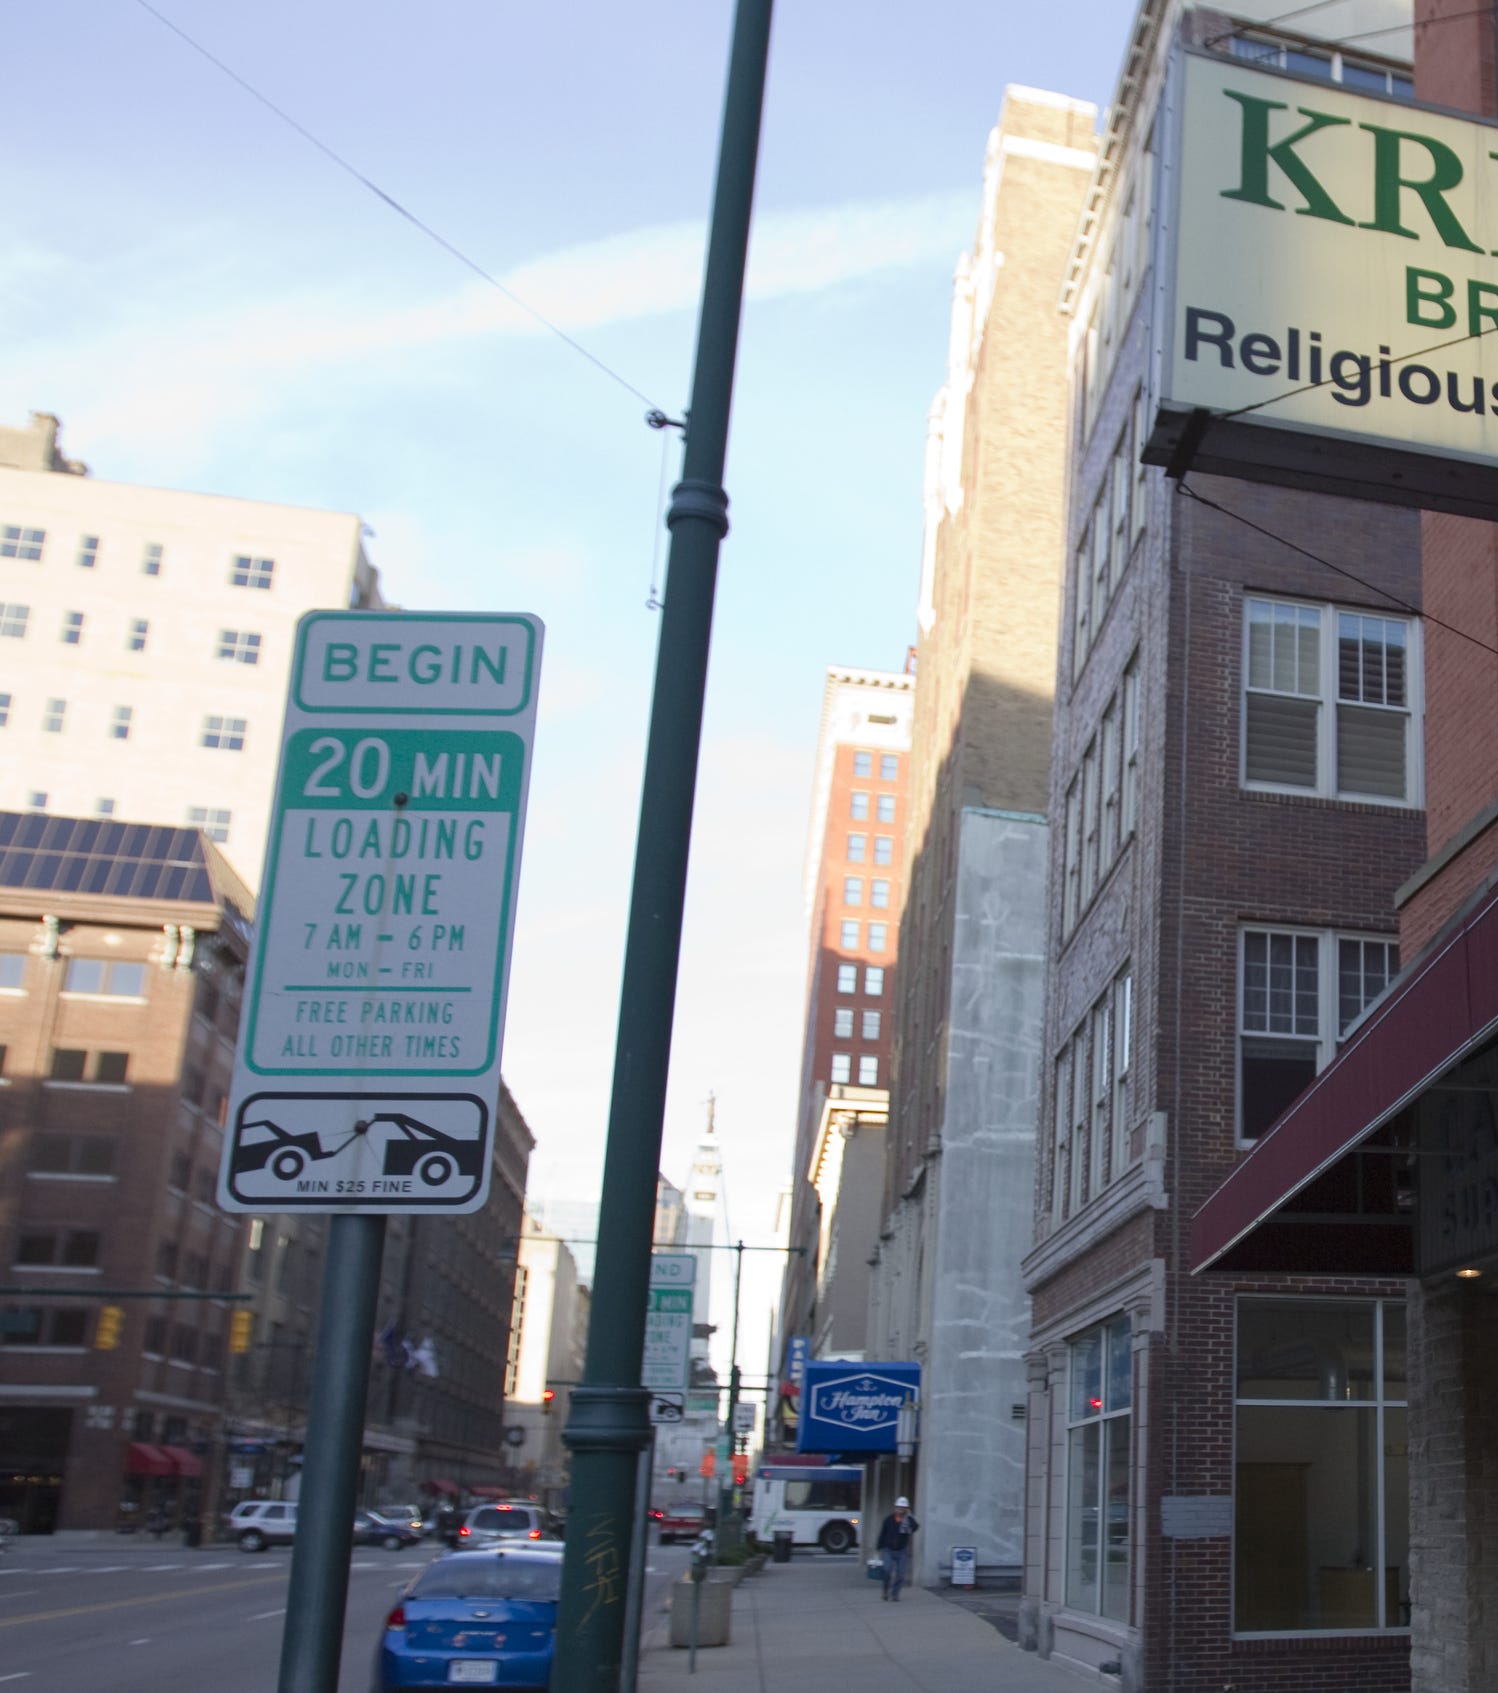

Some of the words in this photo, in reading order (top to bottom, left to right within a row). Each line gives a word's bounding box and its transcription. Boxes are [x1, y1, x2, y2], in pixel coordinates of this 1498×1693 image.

[322, 642, 509, 685] BEGIN
[303, 736, 391, 798] 20
[412, 753, 502, 800] MIN
[304, 817, 486, 861] LOADING
[335, 873, 442, 916] ZONE
[304, 924, 316, 951] 7
[326, 924, 362, 951] AM
[408, 924, 423, 951] 6
[431, 925, 466, 952] PM
[326, 962, 370, 980] MON
[401, 962, 434, 980] FRI
[296, 1001, 348, 1024] FREE
[362, 1001, 455, 1025] PARKING
[281, 1035, 318, 1058] ALL
[330, 1035, 394, 1058] OTHER
[405, 1036, 461, 1059] TIMES
[296, 1180, 329, 1193] MIN
[336, 1180, 366, 1194] $25
[371, 1180, 413, 1194] FINE
[820, 1390, 904, 1411] Hampton
[840, 1406, 888, 1423] Inn
